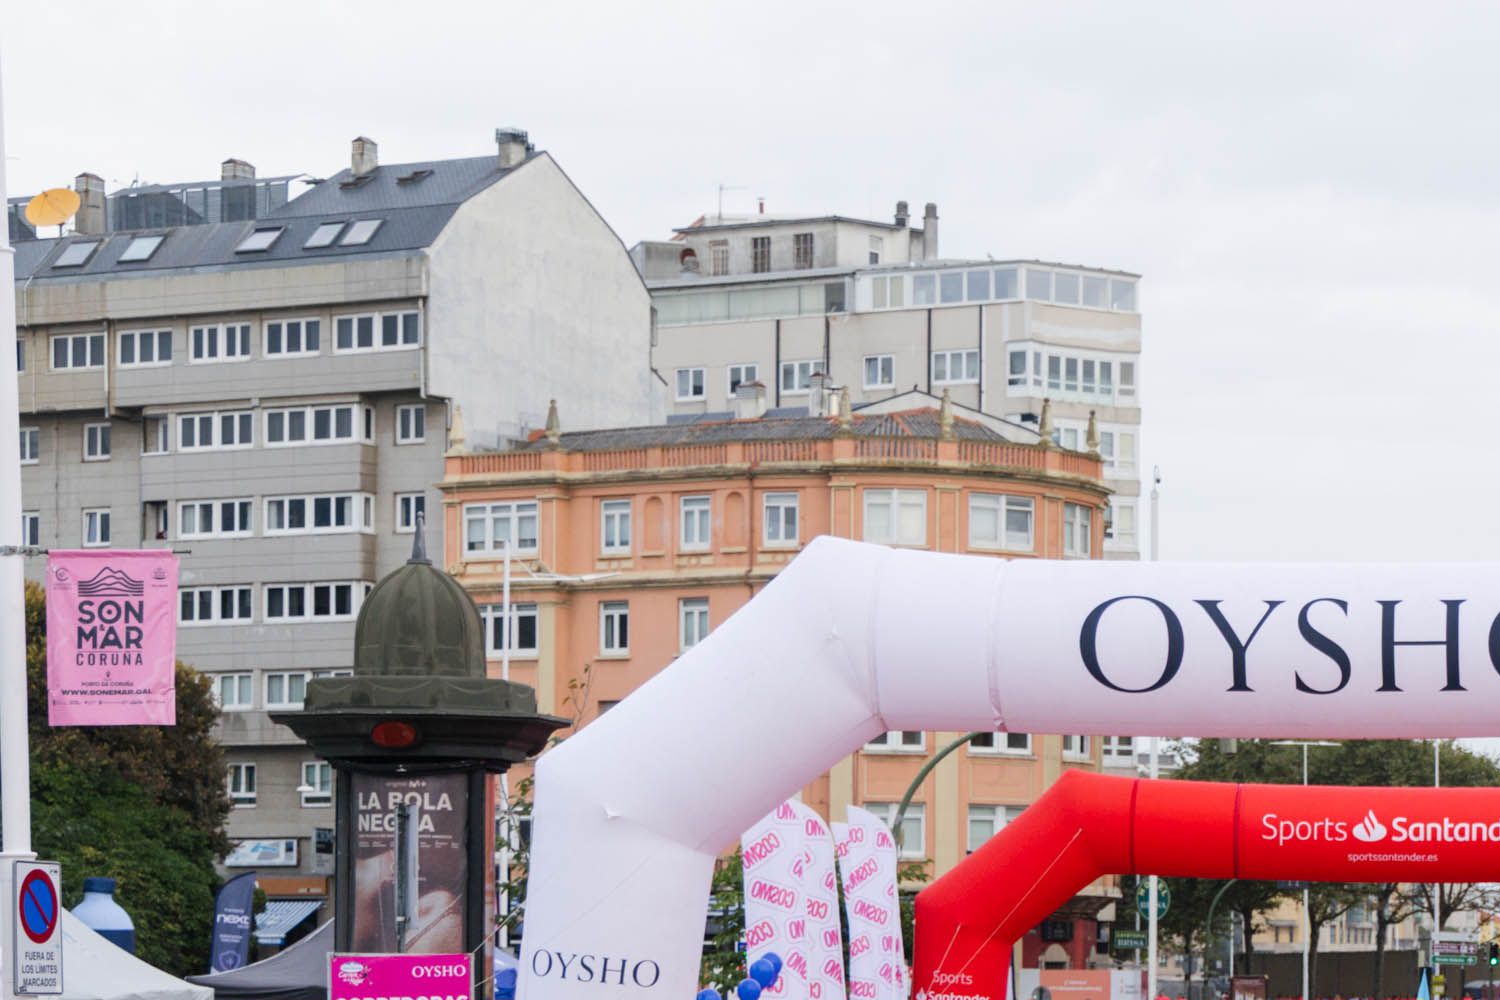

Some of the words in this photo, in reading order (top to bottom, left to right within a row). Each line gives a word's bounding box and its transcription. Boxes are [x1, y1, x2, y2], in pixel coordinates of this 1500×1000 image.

[78, 600, 144, 624] SON
[77, 626, 144, 650] MAR
[76, 651, 144, 666] CORUÑA
[358, 792, 381, 810] LA
[358, 813, 435, 833] NEGA
[1261, 813, 1348, 846] Sports
[1347, 853, 1439, 865] sportssantander.es
[25, 951, 45, 961] FUERA
[46, 951, 55, 961] DE
[21, 964, 34, 974] LOS
[411, 964, 467, 979] OYSHO
[532, 948, 661, 989] OYSHO
[22, 977, 57, 987] MARCADOS
[932, 970, 974, 985] Sports
